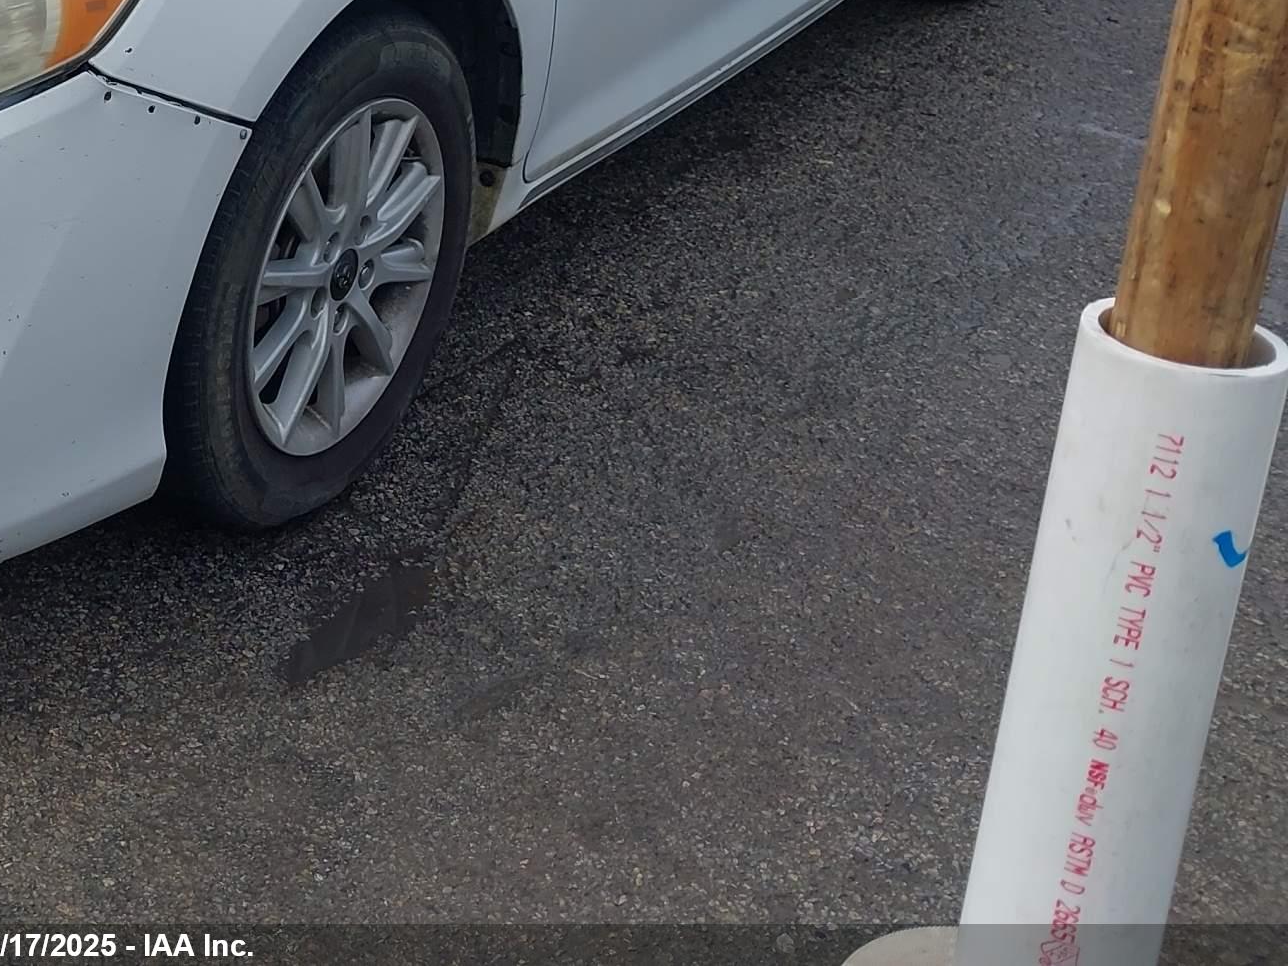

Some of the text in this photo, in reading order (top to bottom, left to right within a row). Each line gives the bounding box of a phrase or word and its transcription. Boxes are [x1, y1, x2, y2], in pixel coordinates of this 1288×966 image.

[1150, 433, 1184, 480] 7112
[1124, 560, 1156, 597] PVC
[1113, 606, 1146, 650] TYPE
[1093, 728, 1118, 751] 40
[1063, 832, 1096, 877] ASTM
